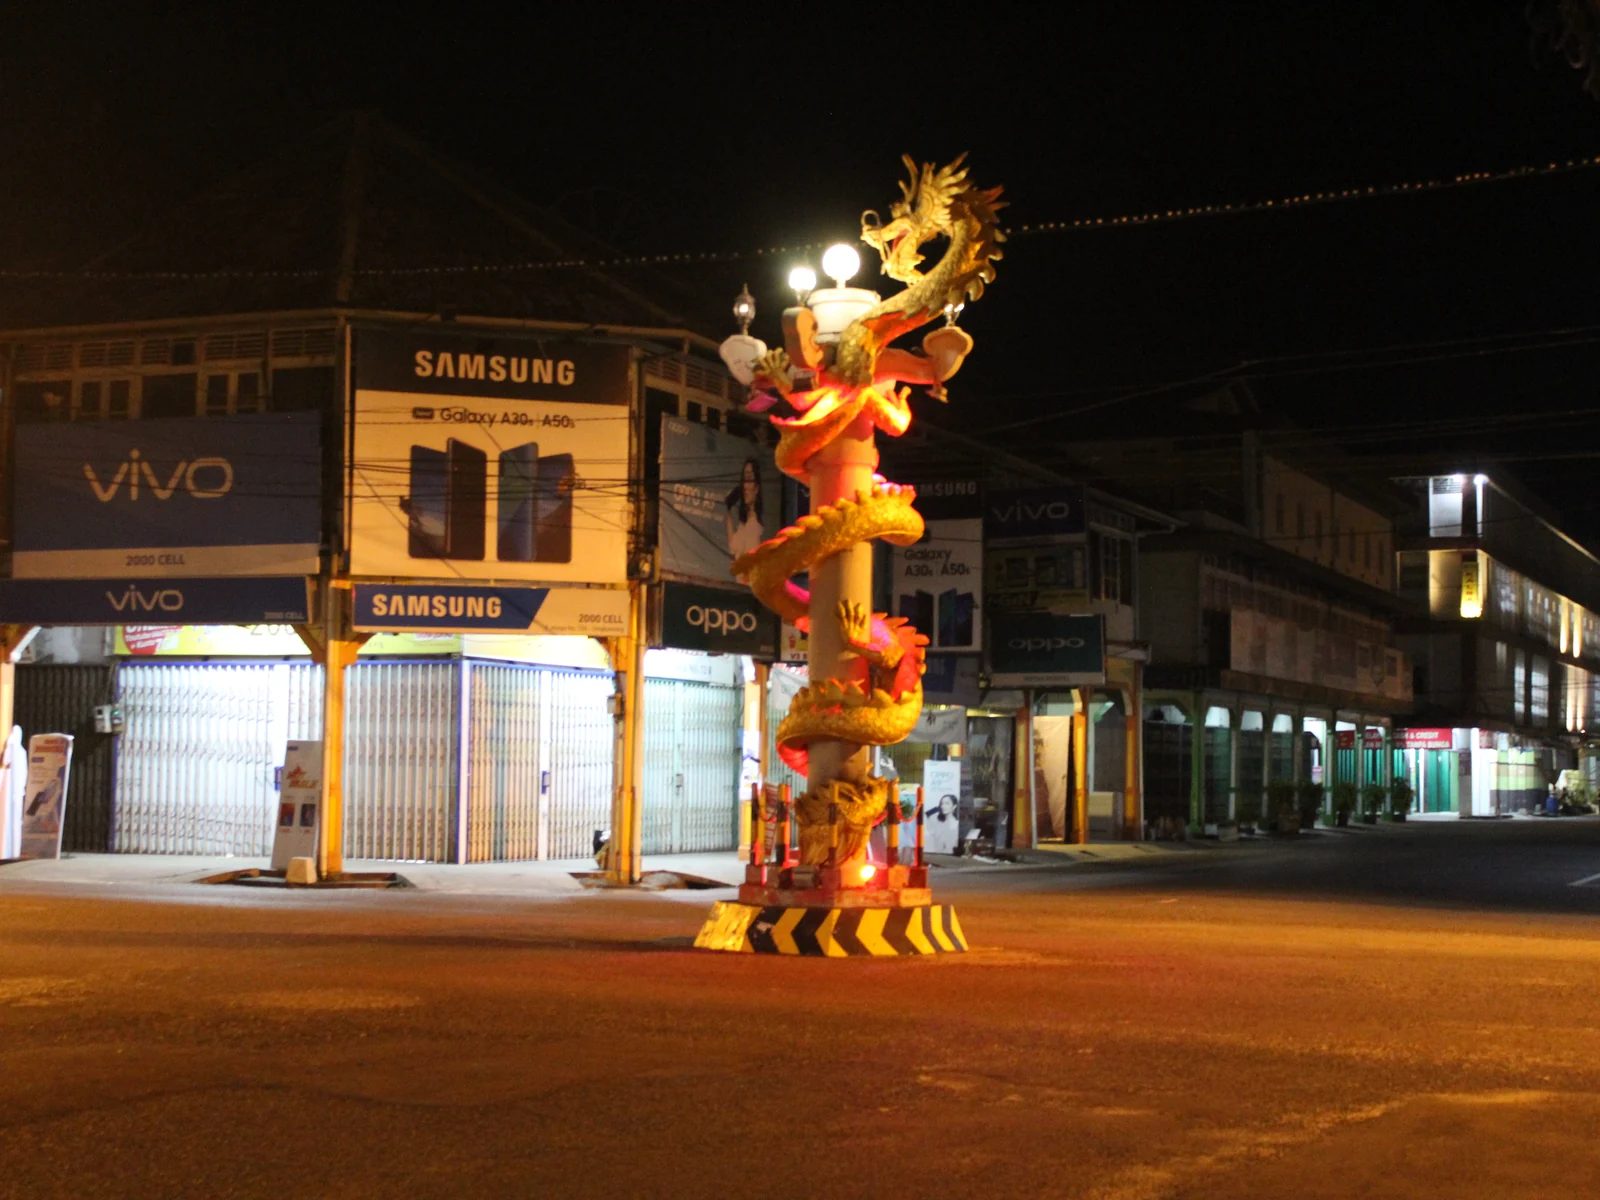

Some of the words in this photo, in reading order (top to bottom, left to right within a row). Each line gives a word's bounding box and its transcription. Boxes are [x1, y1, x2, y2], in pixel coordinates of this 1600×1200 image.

[414, 350, 576, 386] SAMSUNG
[440, 407, 497, 428] Galaxy
[83, 447, 235, 503] vivo
[918, 481, 976, 496] MSUNG
[991, 500, 1070, 523] vivo
[126, 555, 155, 566] 2000
[158, 554, 185, 566] CELL
[904, 548, 951, 567] Galaxy
[904, 564, 933, 577] A30s
[940, 563, 970, 577] A50s
[105, 584, 184, 612] vivo
[372, 593, 502, 619] SAMSUNG
[579, 614, 601, 624] 2000
[602, 614, 623, 624] CELL
[686, 605, 757, 636] oppo
[1008, 637, 1084, 654] oppo
